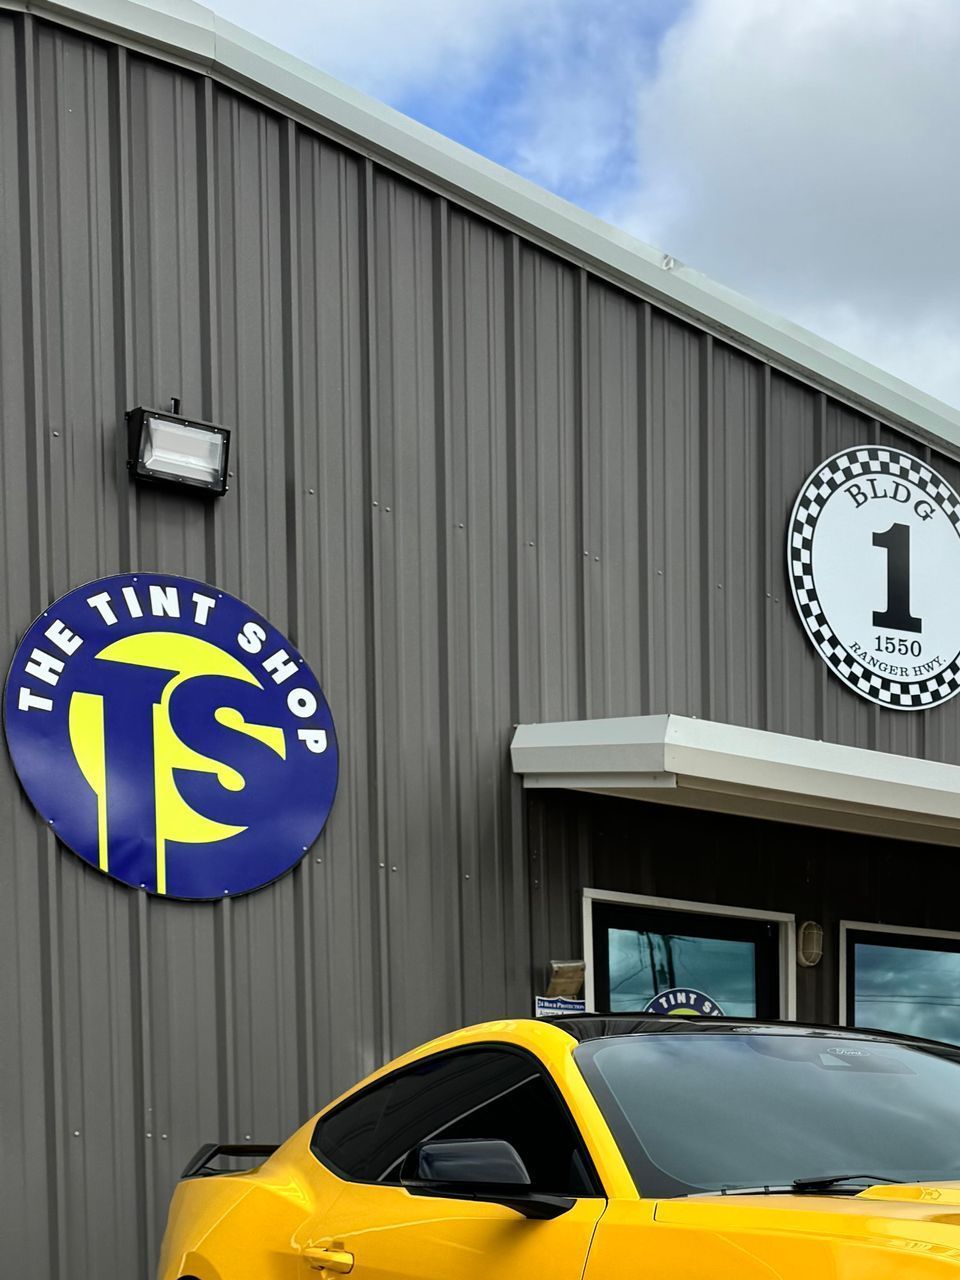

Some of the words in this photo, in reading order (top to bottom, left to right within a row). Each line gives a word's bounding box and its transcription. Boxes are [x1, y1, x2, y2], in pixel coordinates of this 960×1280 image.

[844, 478, 937, 522] BLDG
[872, 522, 923, 634] 1
[849, 641, 910, 677] RANGER
[913, 655, 947, 677] HWY.
[874, 635, 922, 658] 1550
[18, 619, 84, 712] THE
[87, 585, 216, 626] TINT
[237, 621, 328, 754] SHOP
[659, 992, 697, 1009] TINT
